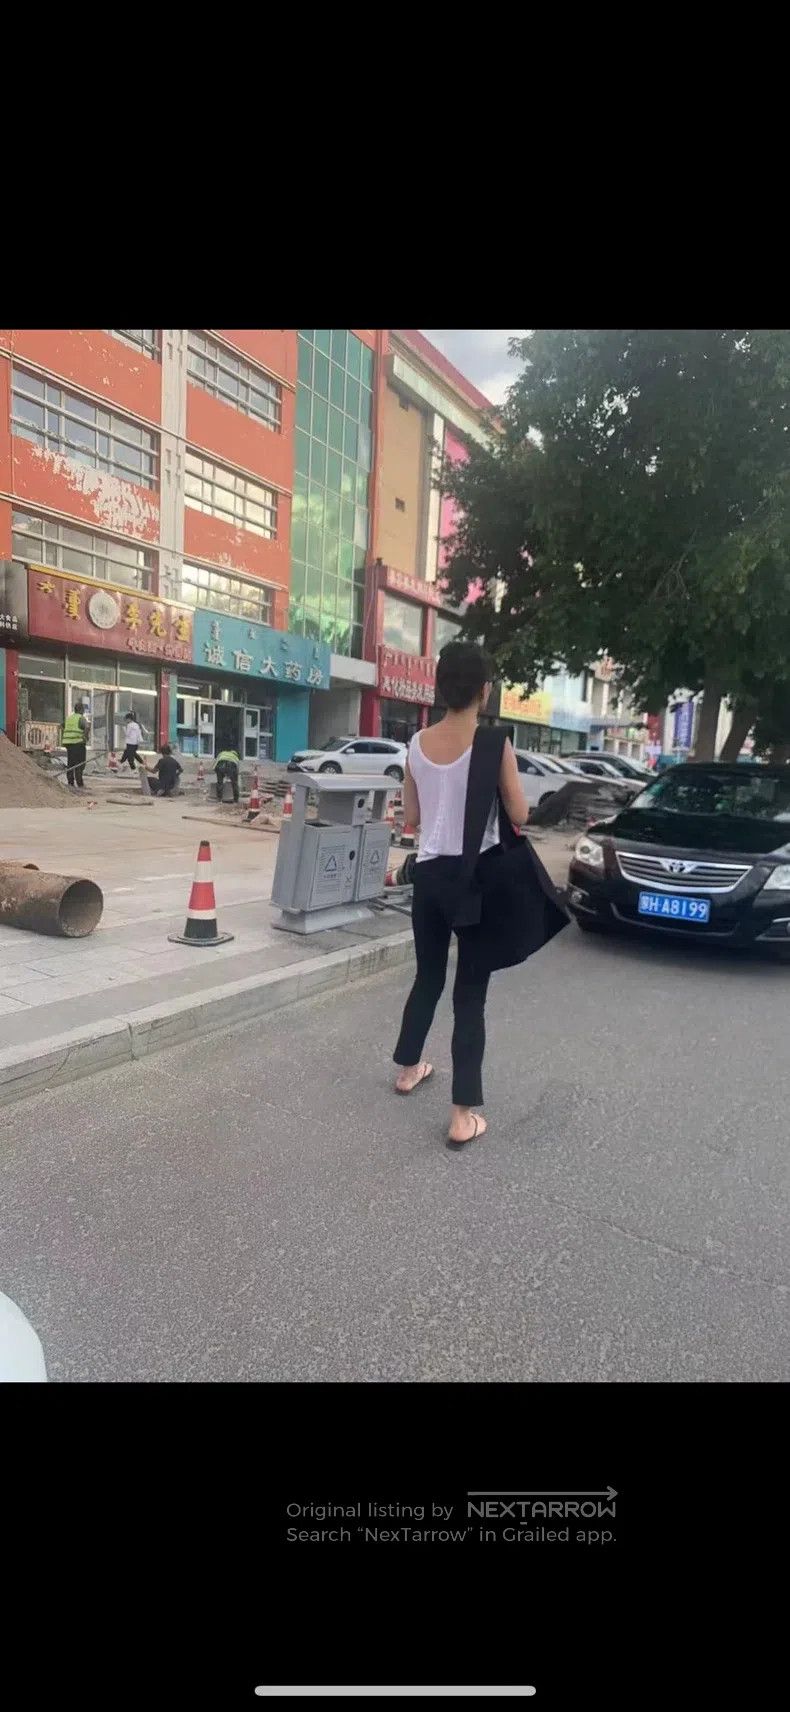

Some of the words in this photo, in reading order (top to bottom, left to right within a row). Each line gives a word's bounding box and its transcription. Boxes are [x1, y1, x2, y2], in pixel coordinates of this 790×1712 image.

[203, 641, 323, 685] 诚信大药房
